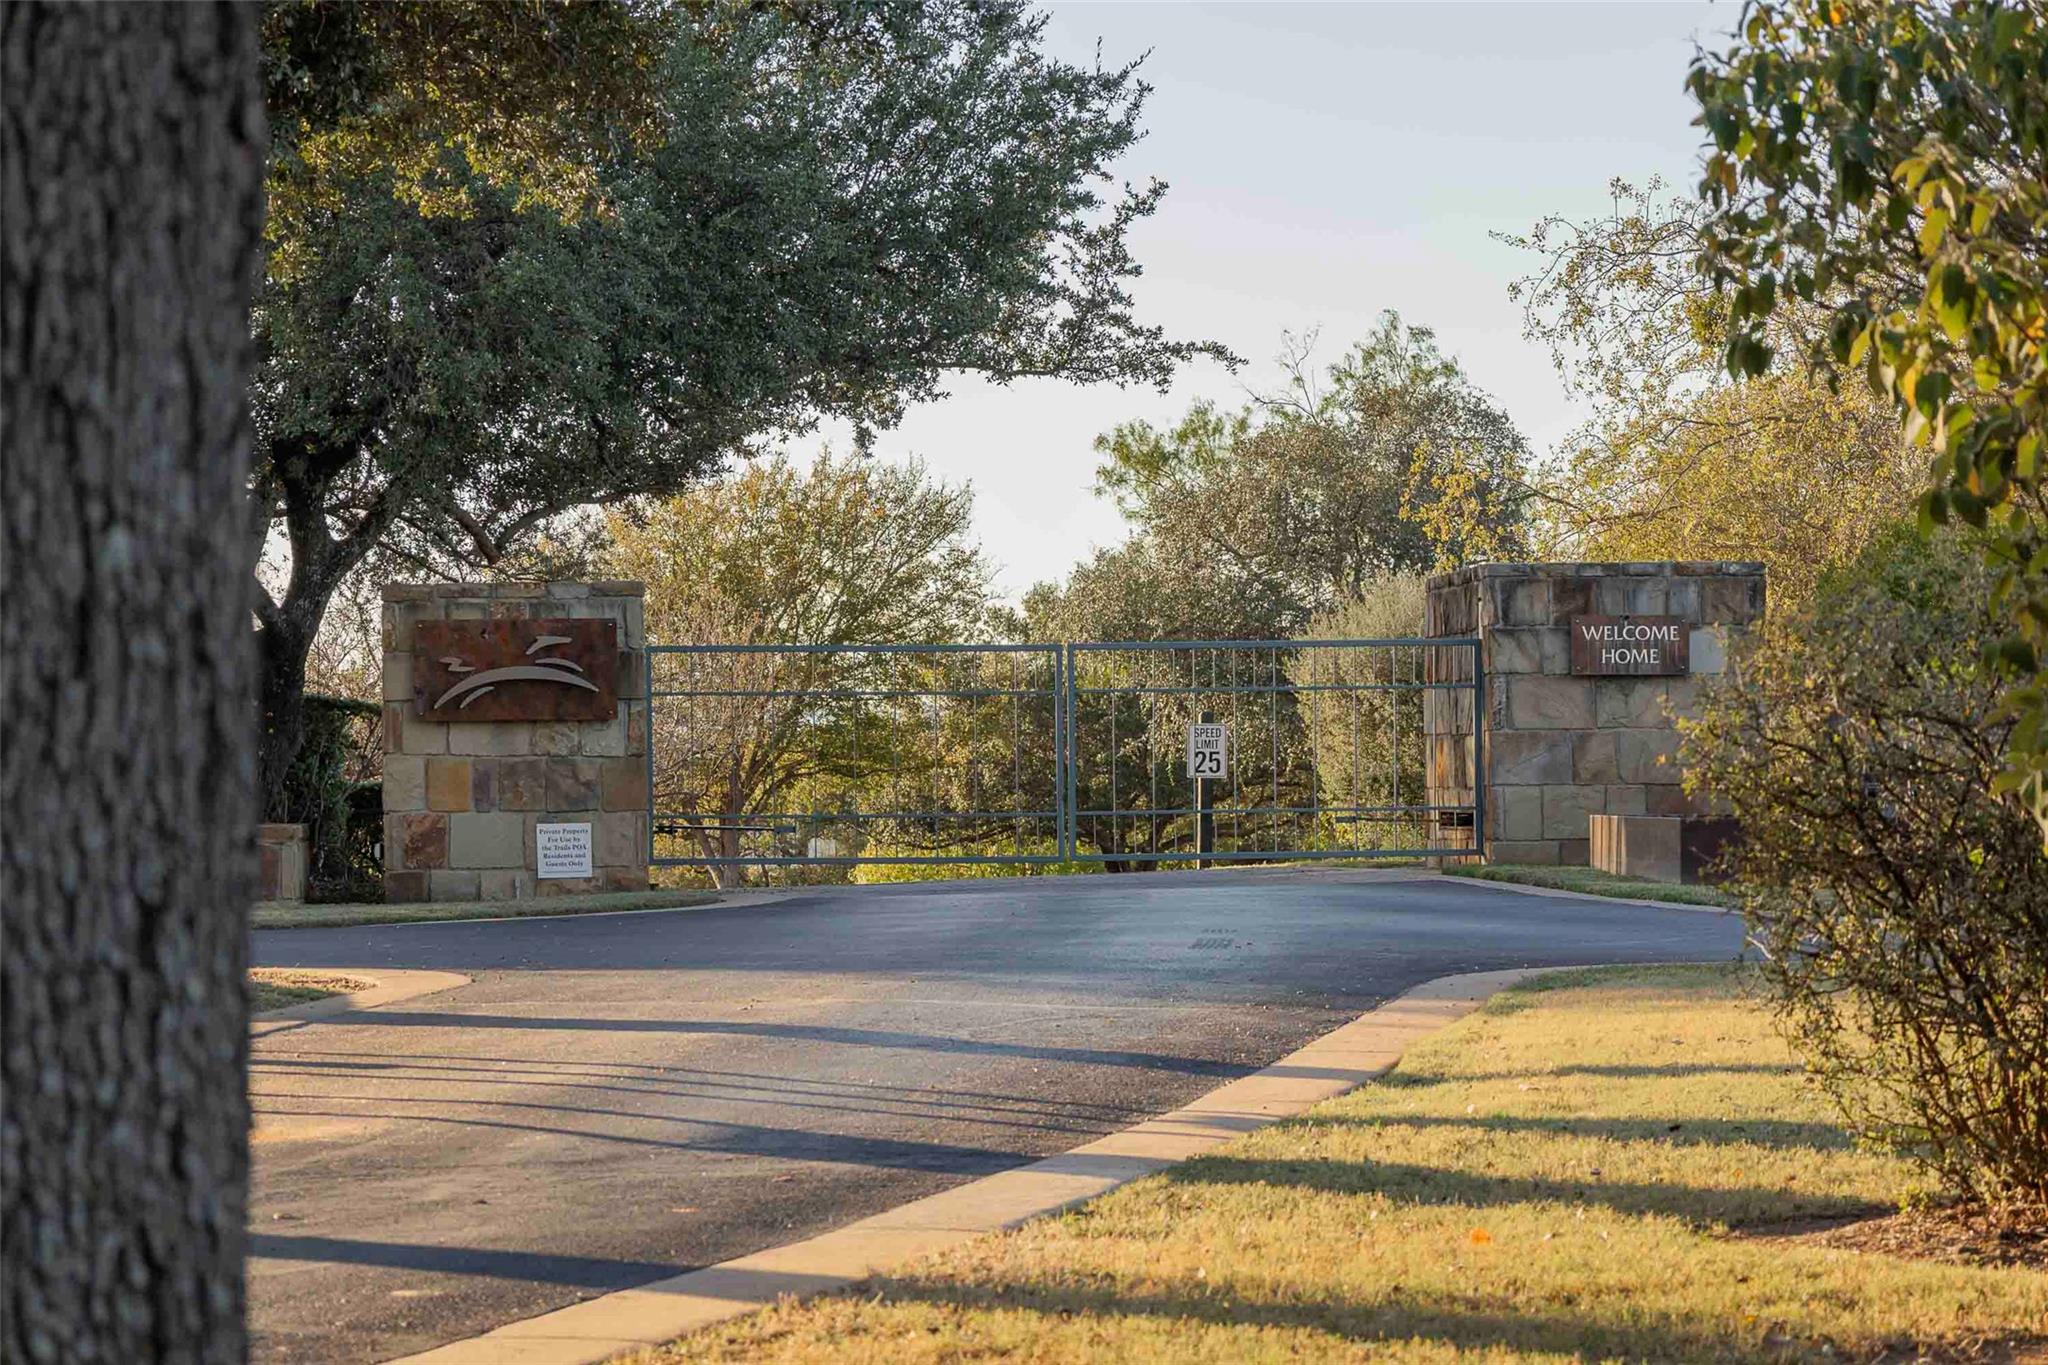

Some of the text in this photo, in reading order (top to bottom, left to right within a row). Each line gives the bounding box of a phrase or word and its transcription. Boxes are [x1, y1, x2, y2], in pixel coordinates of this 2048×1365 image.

[1582, 625, 1680, 640] WELCOME
[1602, 648, 1660, 664] HOME
[1194, 727, 1222, 738] SPEED
[1196, 739, 1219, 749] LIMIT
[1195, 751, 1221, 773] 25
